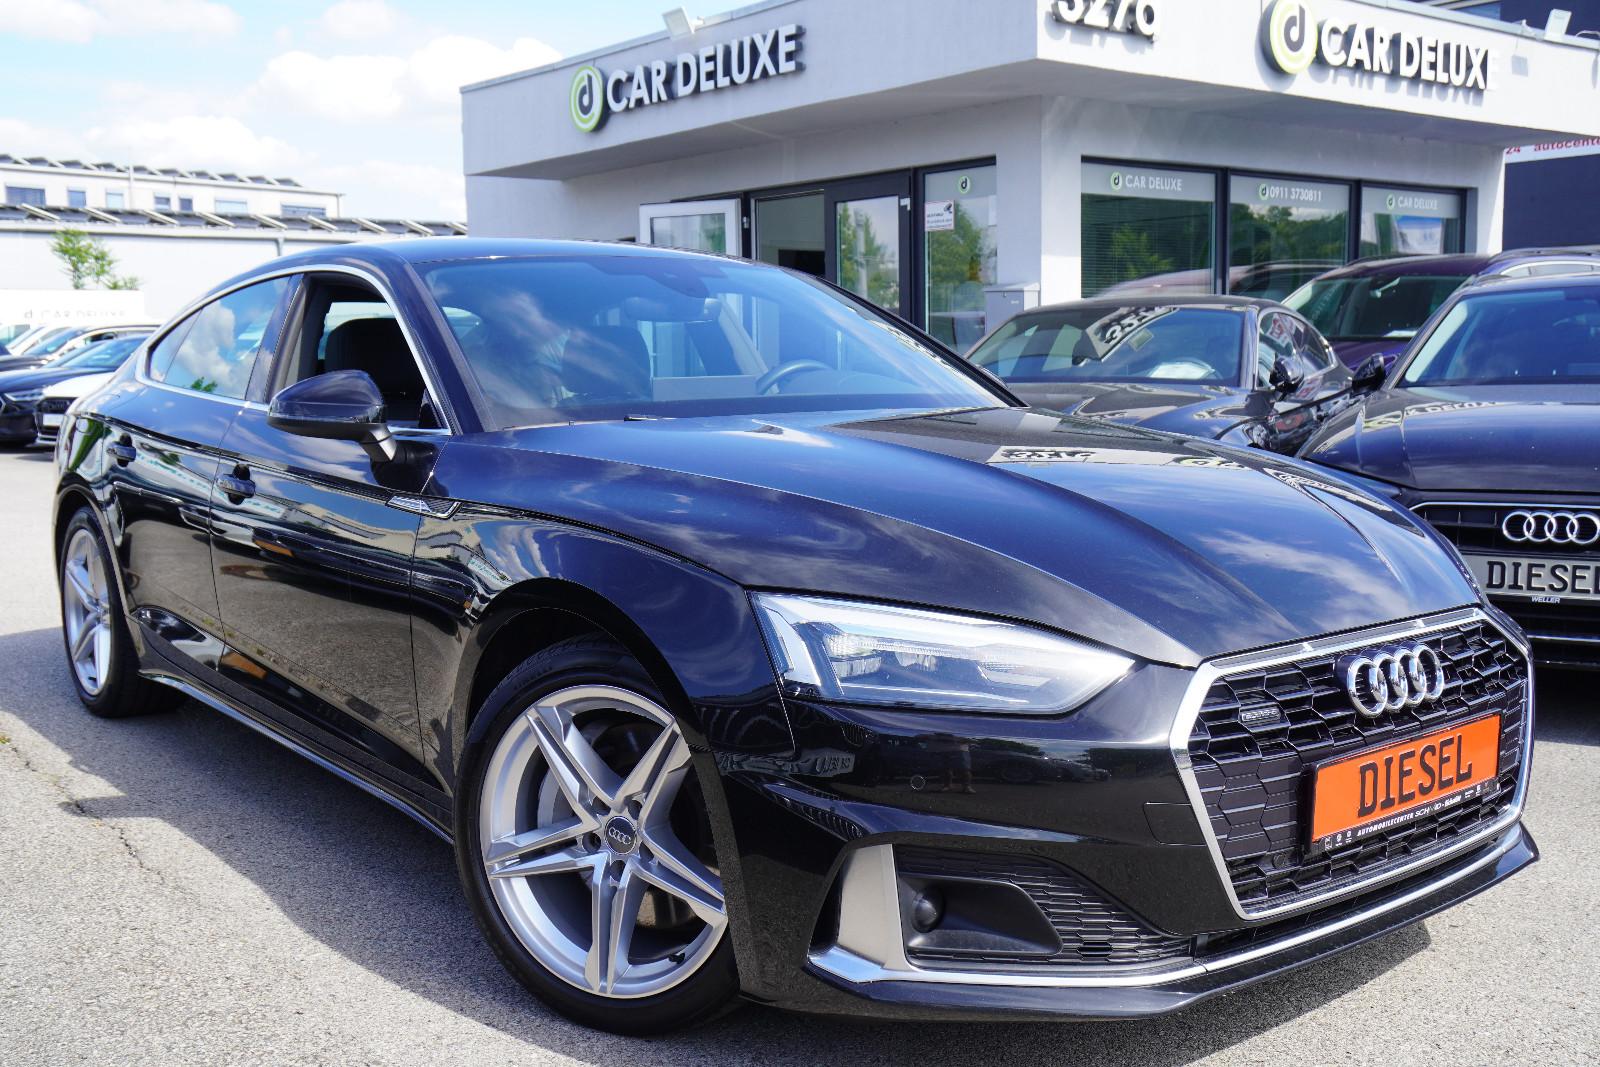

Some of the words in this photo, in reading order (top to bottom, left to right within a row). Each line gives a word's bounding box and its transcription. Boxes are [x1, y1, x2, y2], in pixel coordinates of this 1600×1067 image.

[1320, 17, 1393, 74] CAR
[606, 59, 668, 113] CAR
[676, 23, 798, 98] DELUXE
[1125, 174, 1146, 189] CAR
[1148, 176, 1183, 192] DELUXE
[1269, 186, 1289, 199] 0911
[1290, 187, 1322, 203] 3730811
[1397, 195, 1413, 209] CAR
[1531, 596, 1561, 604] WELLER
[1357, 733, 1473, 818] DIESEL
[1356, 812, 1415, 837] AUTOMOBILECENTER
